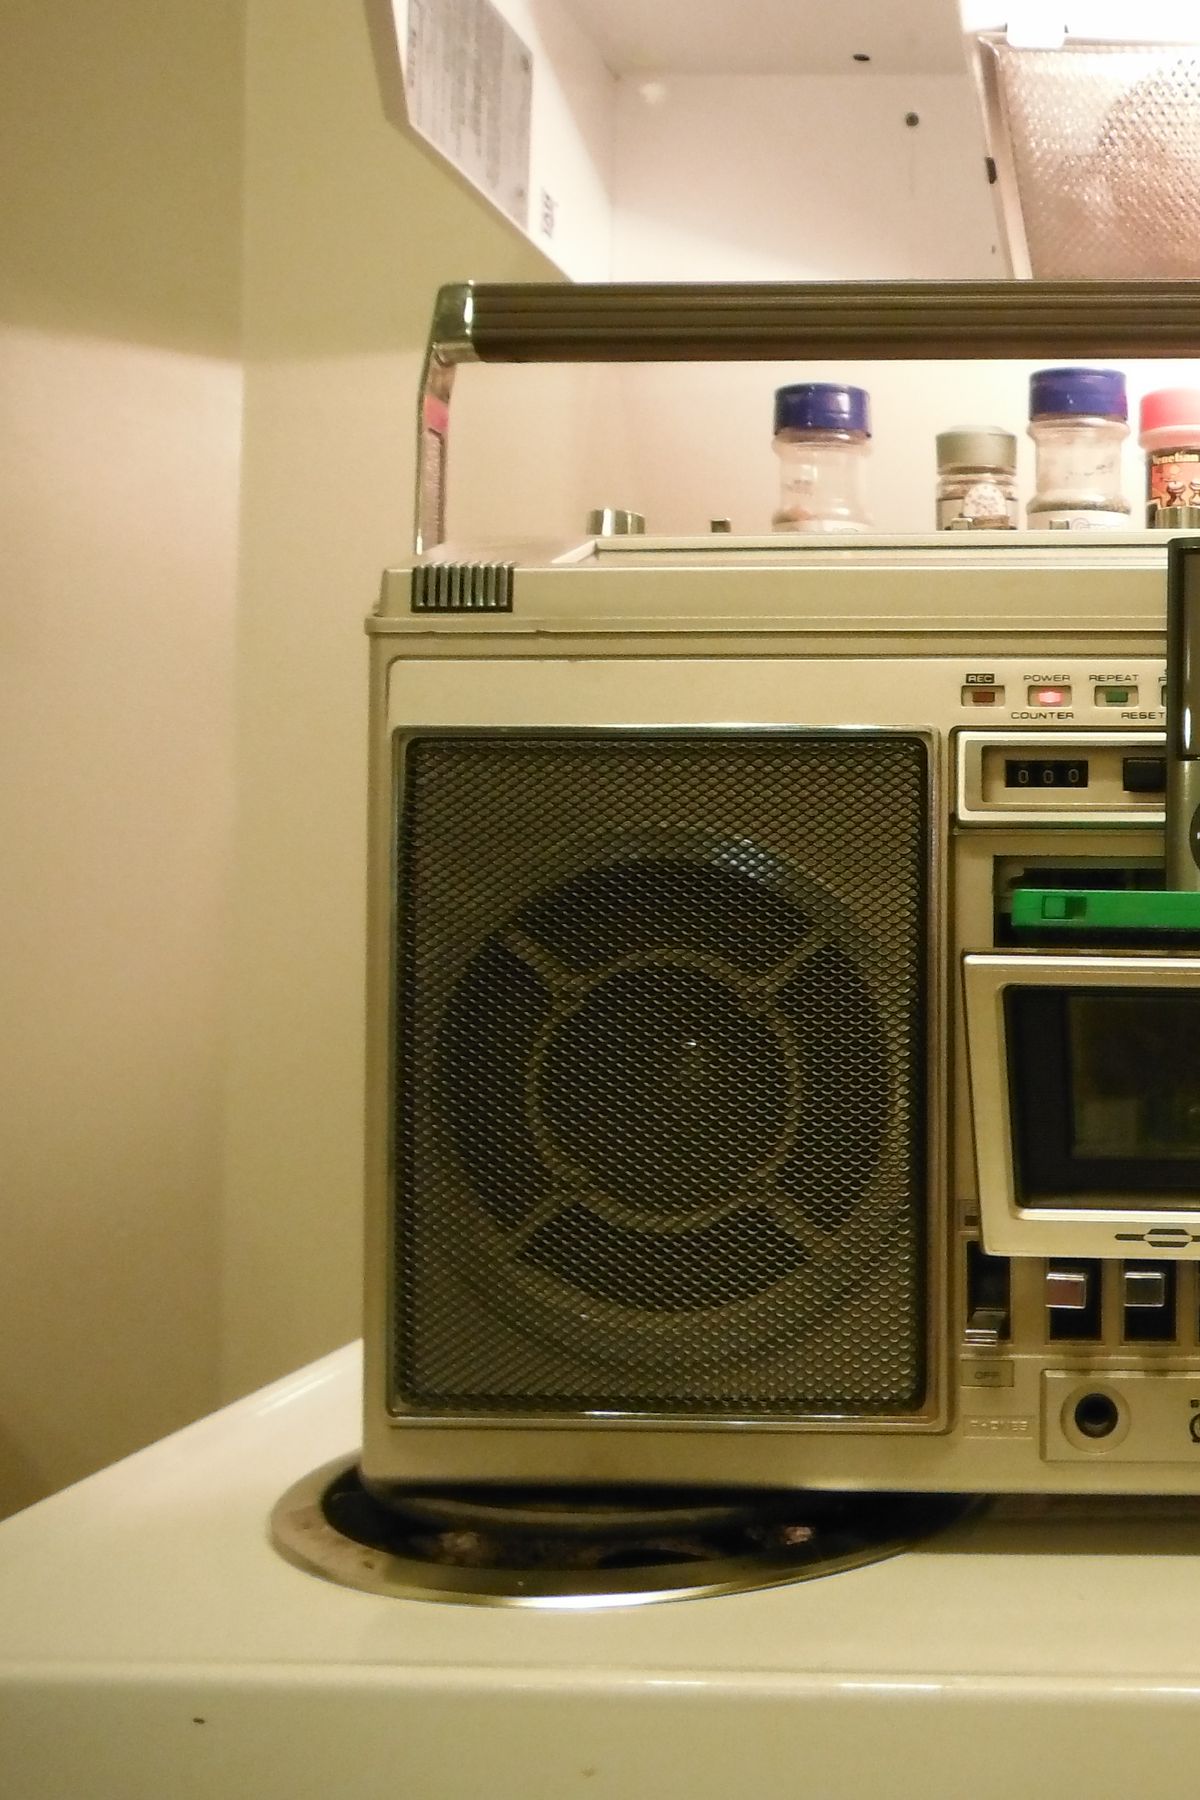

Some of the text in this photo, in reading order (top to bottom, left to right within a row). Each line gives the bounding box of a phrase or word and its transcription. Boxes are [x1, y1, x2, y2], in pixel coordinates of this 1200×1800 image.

[968, 674, 993, 683] REC
[1023, 674, 1070, 682] POWER
[1089, 674, 1139, 682] REPEAT
[1011, 711, 1074, 720] COUNTER
[1121, 711, 1166, 720] RESET
